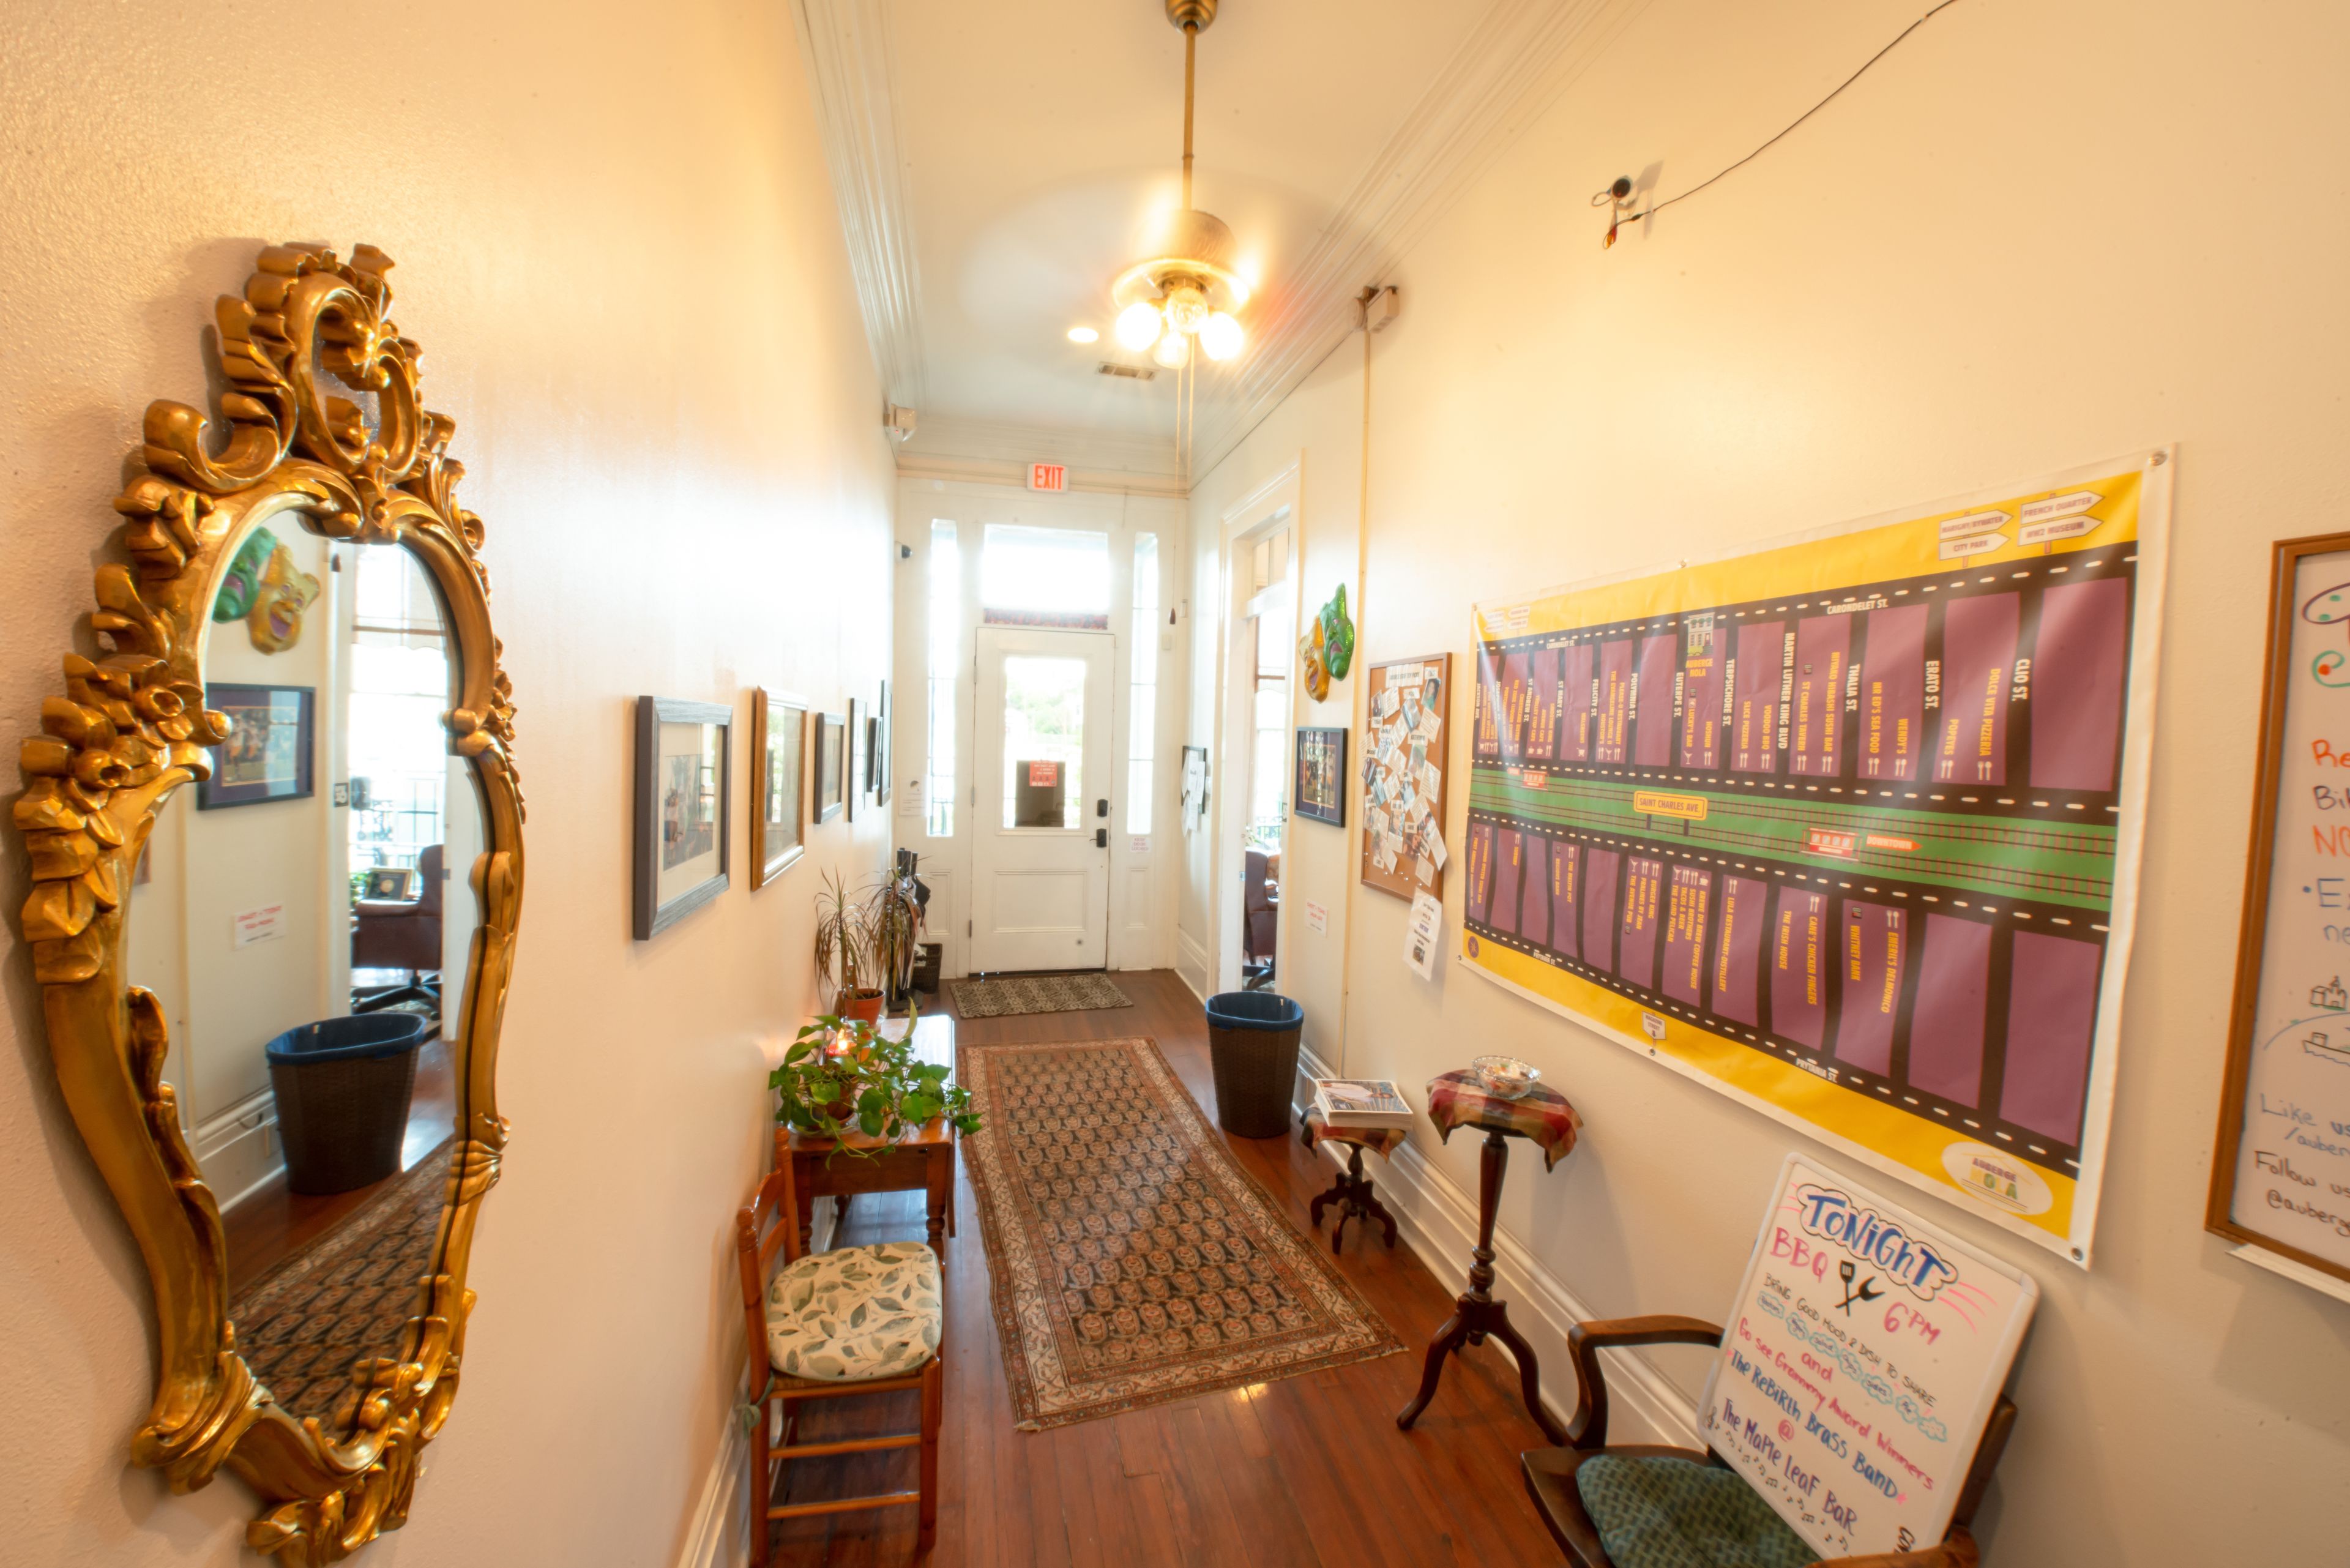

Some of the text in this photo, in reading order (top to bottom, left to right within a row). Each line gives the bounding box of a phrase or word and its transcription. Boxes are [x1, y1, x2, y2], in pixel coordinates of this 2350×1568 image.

[1035, 465, 1064, 490] EXIT
[2024, 497, 2092, 517] FRENCH QUARTER
[2048, 521, 2084, 534] MUSEUM
[1953, 540, 1988, 552] CITY PARK
[1827, 599, 1888, 614] CARONDELET ST.
[1685, 658, 1713, 677] AUBERGE NOLA
[1829, 652, 1840, 680] MIYAKO
[2011, 659, 2031, 701] CLIO ST.
[1630, 673, 1638, 709] POLYMNIA
[1674, 672, 1684, 705] EUTERPE
[1723, 659, 1735, 726] TERPSICHORE ST.
[1778, 632, 1795, 749] MARTIN LUTHER KING BLVD
[1846, 664, 1860, 712] THALIA ST.
[1925, 660, 1939, 709] ERATO ST.
[1761, 705, 1772, 750] VOODOO BBQ
[1797, 681, 1810, 751] ST CHARLES TAVERN
[1825, 713, 1835, 735] SUSHI
[1870, 682, 1882, 753] MR ED'S SEA FOOD
[1979, 668, 2001, 756] DOLCE VITA PIZZERIA
[1741, 720, 1750, 749] PIZZERIA
[1824, 737, 1833, 752] BAR
[1897, 719, 1909, 754] WENDY'S
[1944, 719, 1959, 755] POPEYES
[1639, 797, 1700, 813] SAINT CHARLES AVE.
[1867, 836, 1912, 849] DOWNTOWN
[1638, 906, 1644, 914] BY
[1685, 908, 1695, 941] BROTHERS
[1698, 913, 1704, 924] DU
[1667, 917, 1676, 943] PELICAN
[1695, 924, 1703, 943] BREW
[1779, 911, 1792, 970] THE IRISH HOUSE
[1692, 943, 1701, 968] COFFEE
[1719, 914, 1733, 992] RESTAURANT-DISTILLERY
[1807, 916, 1818, 1006] CANE'S CHICKEN FINGERS
[1850, 925, 1860, 982] WHITNEY BANK
[1690, 968, 1698, 990] HOUSE
[1881, 931, 1899, 1014] EMERIL'S DELMONICO
[1796, 1058, 1838, 1083] PRYTANIA ST.
[2260, 1092, 2317, 1126] Like
[1969, 1164, 2018, 1200] NOLA
[1972, 1157, 2017, 1182] AUBERGE
[2254, 1150, 2316, 1187] Follow
[1770, 1227, 1828, 1283] BBQ
[1731, 1348, 1751, 1376] The
[1801, 1353, 1833, 1383] and
[1739, 1317, 1751, 1341] Go
[1775, 1351, 1826, 1413] Grammy
[1829, 1397, 1871, 1438] Award
[1876, 1431, 1934, 1490] Winners
[1901, 1375, 1938, 1408] SHARE
[1723, 1397, 1741, 1431] The
[1778, 1419, 1794, 1443] @
